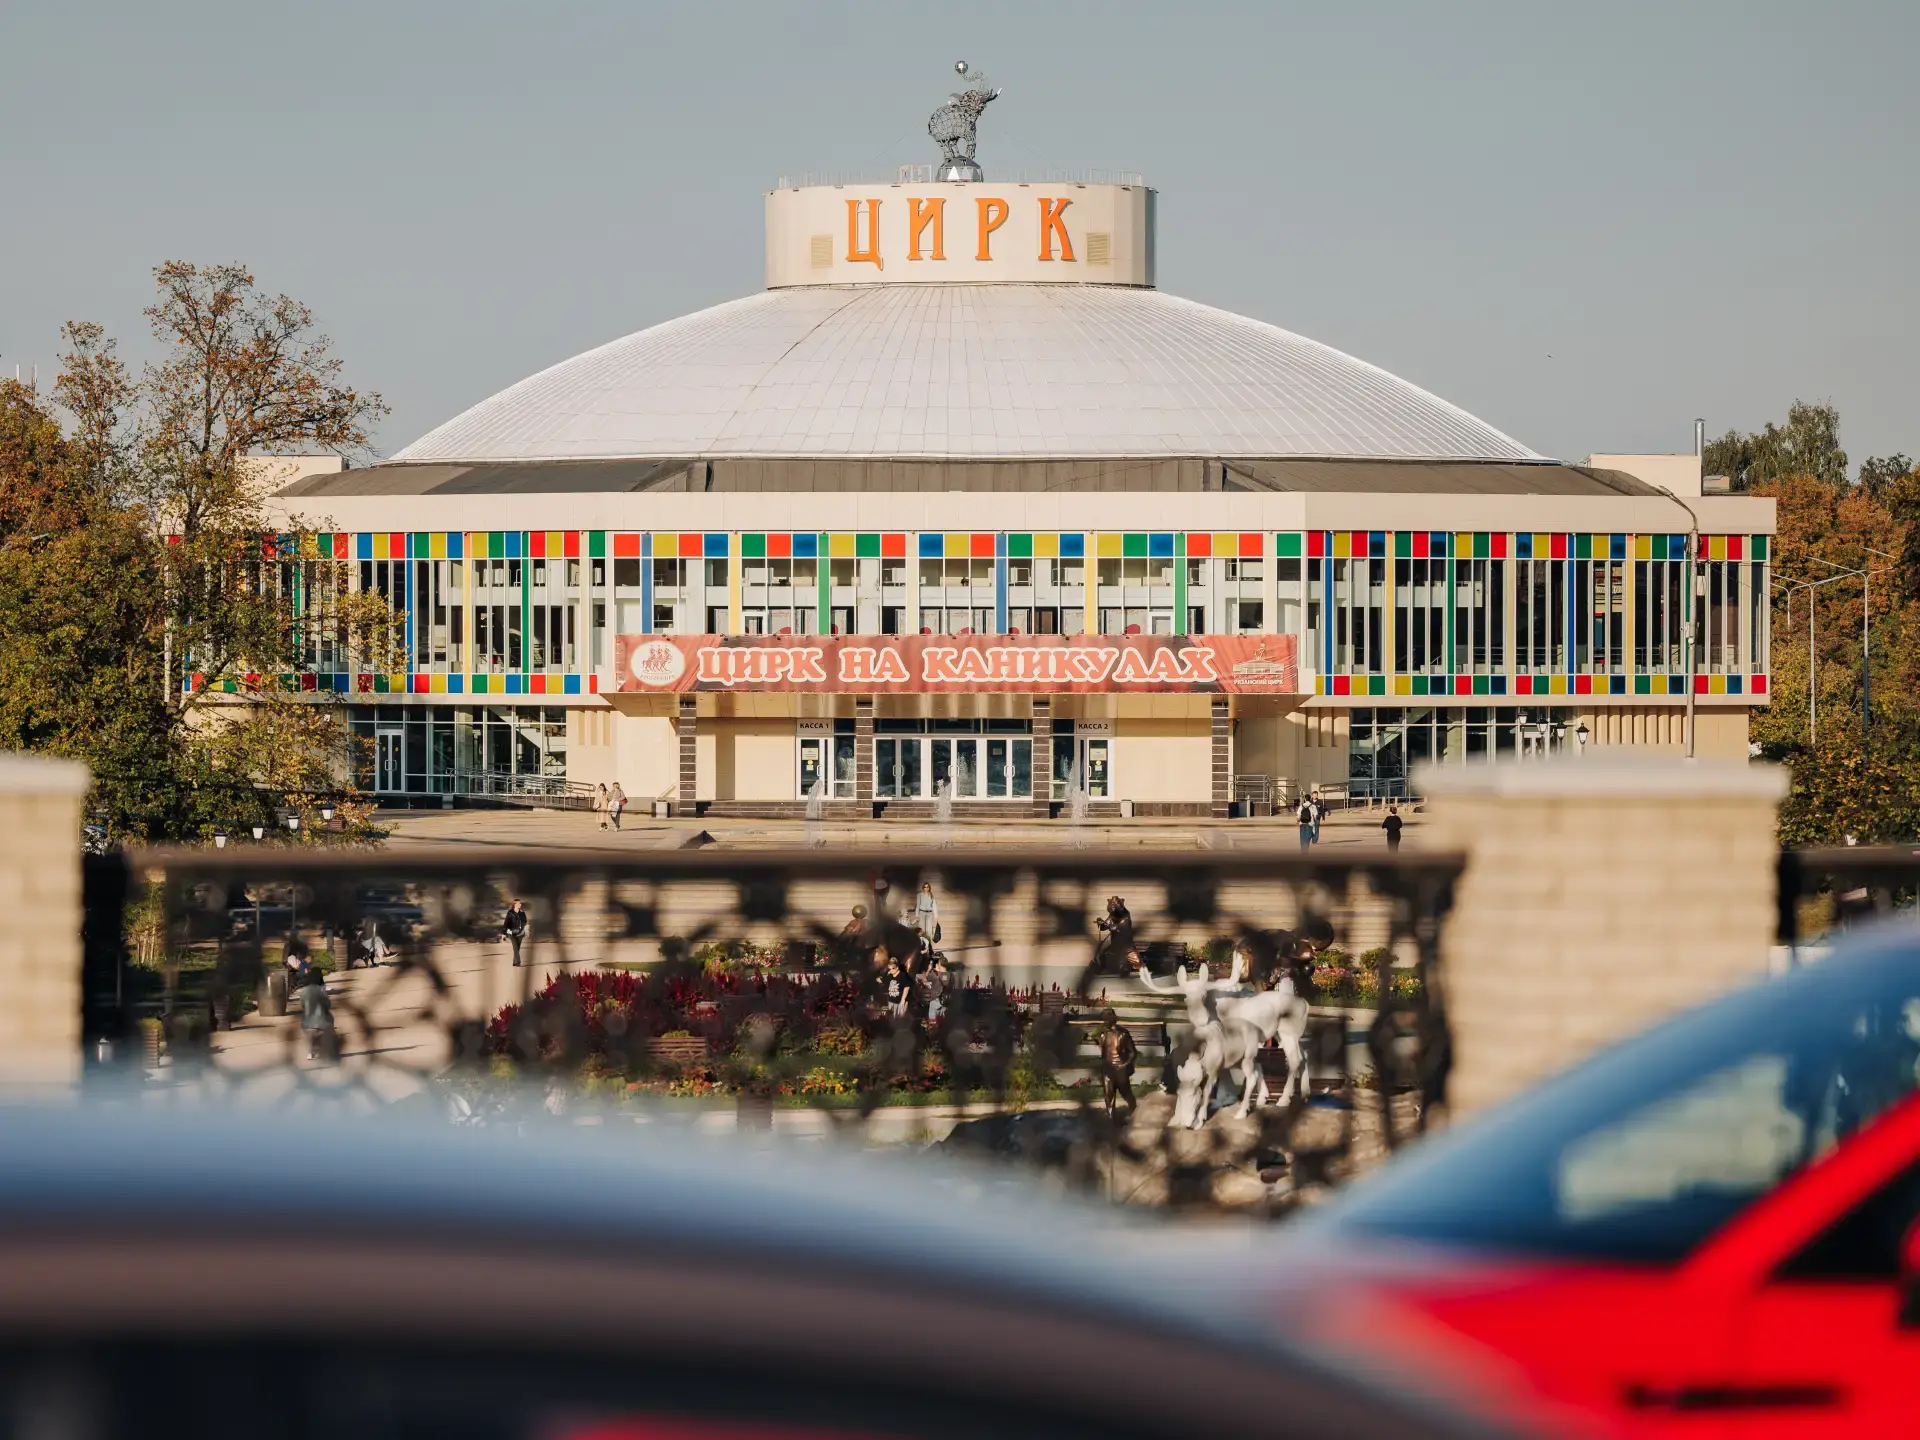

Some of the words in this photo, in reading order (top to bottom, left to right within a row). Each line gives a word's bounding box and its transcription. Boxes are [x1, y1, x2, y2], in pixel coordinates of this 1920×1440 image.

[845, 197, 1077, 271] ЦИРК
[697, 647, 827, 686] ЦИРК
[838, 647, 910, 682] НА
[921, 647, 1217, 683] КАНИКУЛАХ
